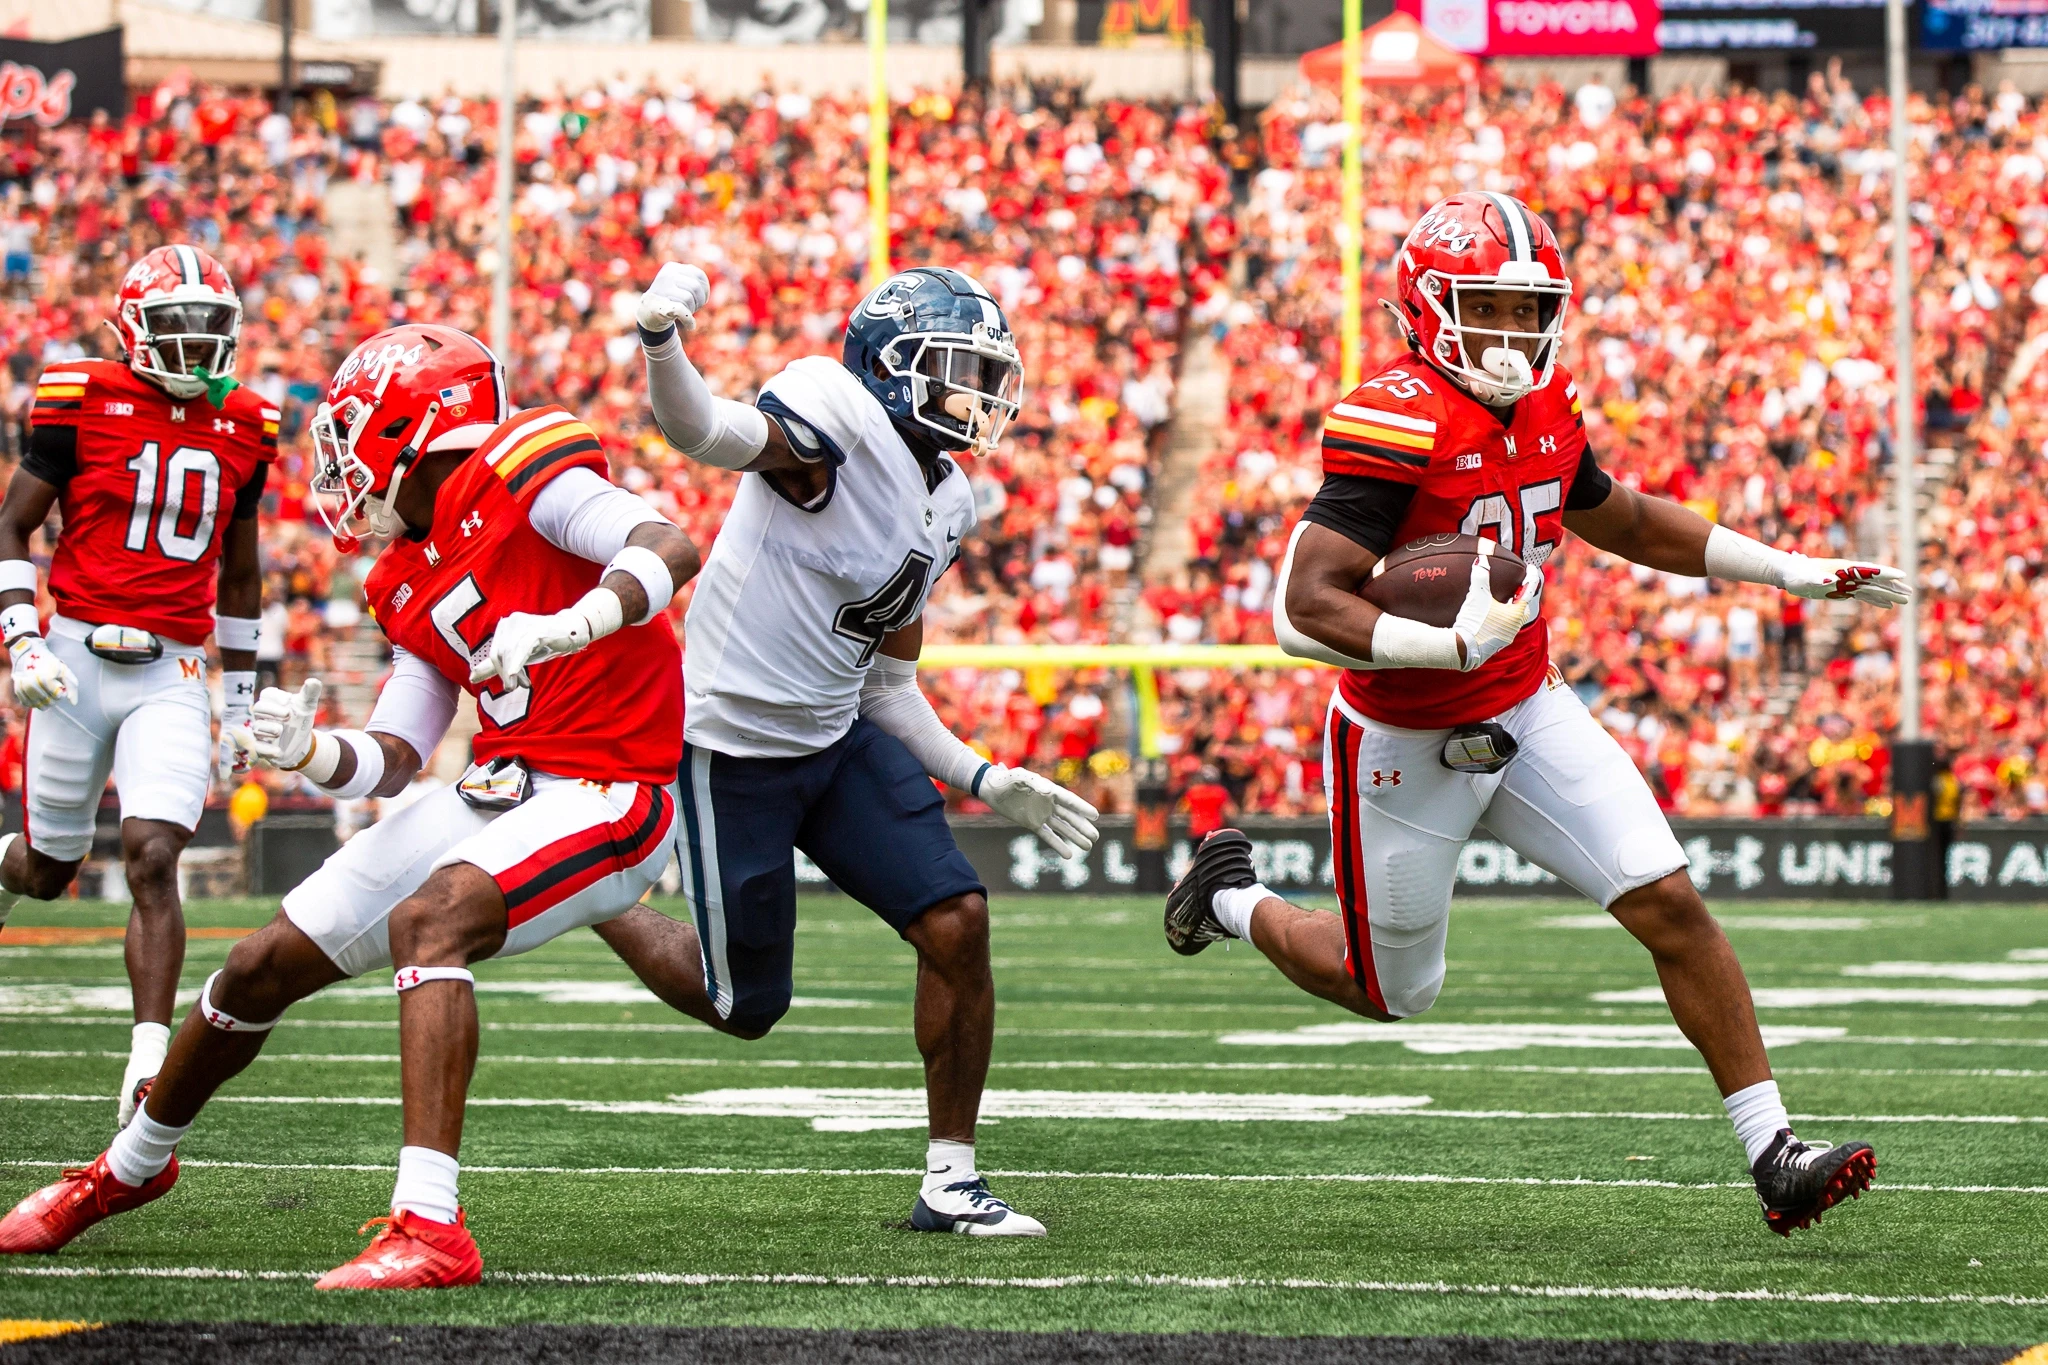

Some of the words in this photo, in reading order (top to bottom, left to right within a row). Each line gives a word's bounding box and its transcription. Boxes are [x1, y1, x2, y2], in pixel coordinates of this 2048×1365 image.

[1494, 1, 1637, 35] TOYOTA
[330, 343, 424, 399] Terps
[1360, 369, 1433, 399] 25
[124, 440, 221, 562] 10
[1411, 567, 1447, 583] Terps
[831, 548, 934, 668] 4
[177, 657, 202, 680] M
